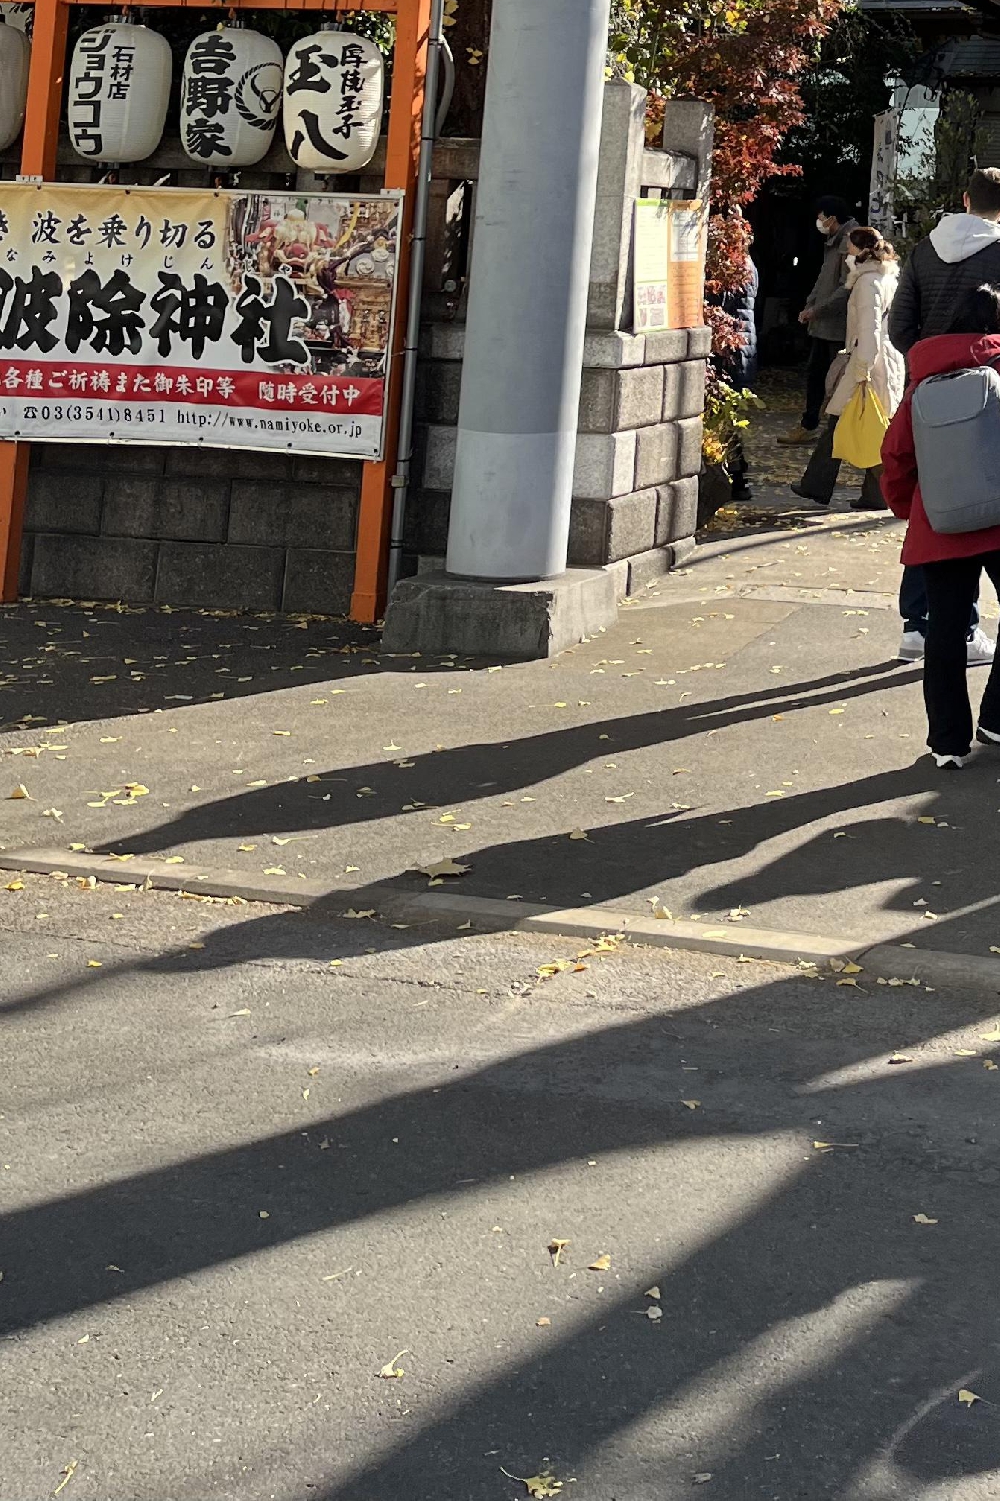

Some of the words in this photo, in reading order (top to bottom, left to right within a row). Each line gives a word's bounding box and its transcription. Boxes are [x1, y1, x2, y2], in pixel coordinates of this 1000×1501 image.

[73, 29, 115, 156] ジョウコウ
[107, 46, 135, 100] 石材店
[186, 35, 237, 158] 吉野家
[286, 45, 349, 160] 玉八
[32, 210, 216, 250] 波を乗り切る
[0, 265, 309, 364] 波除神社
[177, 410, 362, 438] http://www.namiyoke.or.jp
[258, 381, 361, 406] 随時受付中
